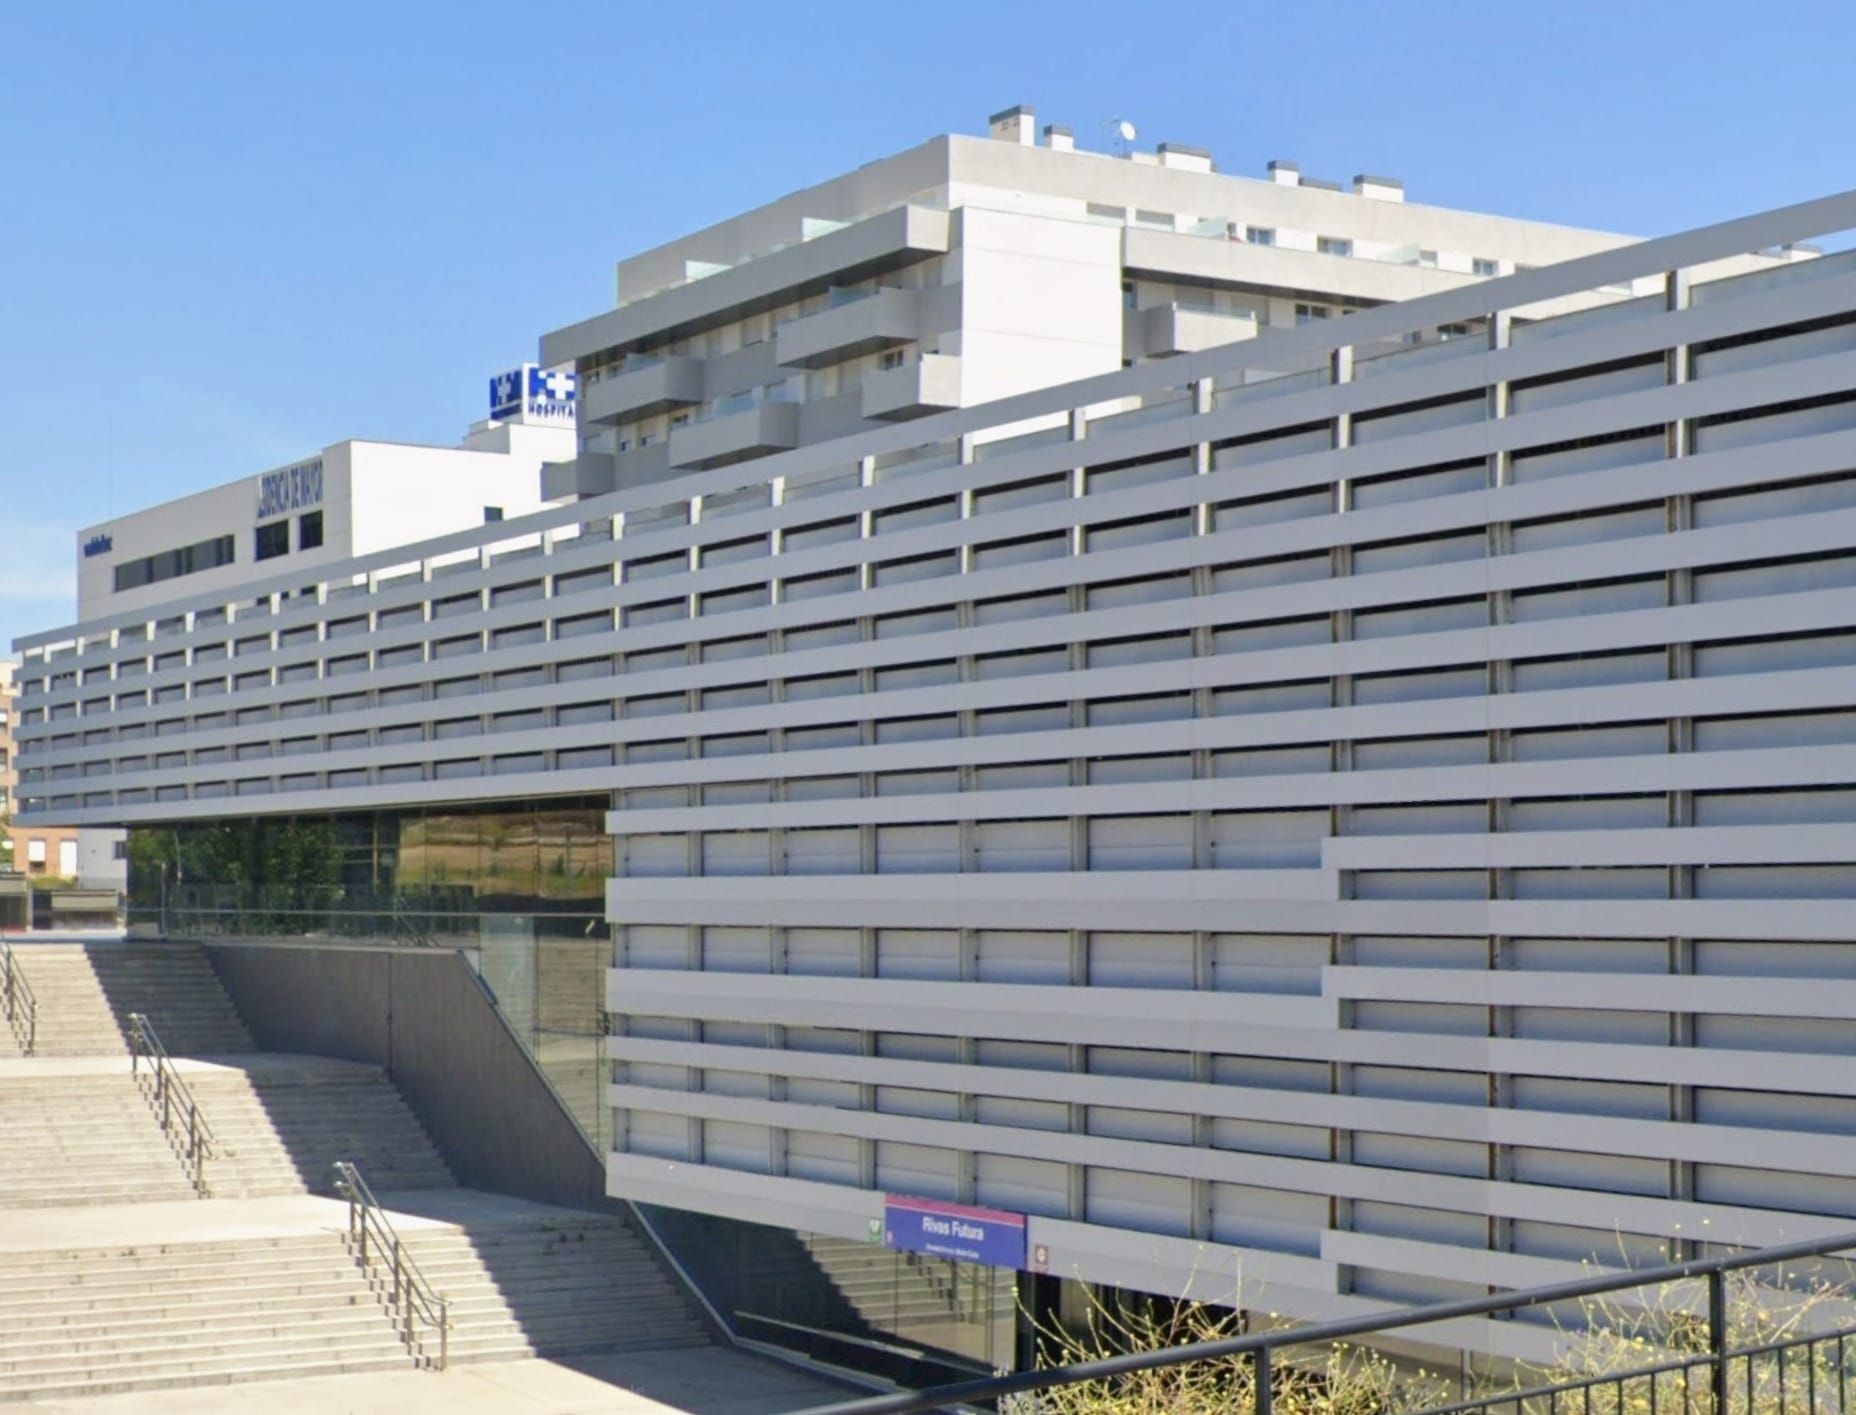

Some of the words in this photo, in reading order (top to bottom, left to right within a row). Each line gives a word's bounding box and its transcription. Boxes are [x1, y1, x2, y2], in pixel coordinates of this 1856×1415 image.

[529, 404, 574, 418] HOSPITA
[922, 1217, 949, 1235] Rivas
[953, 1221, 984, 1240] Futura
